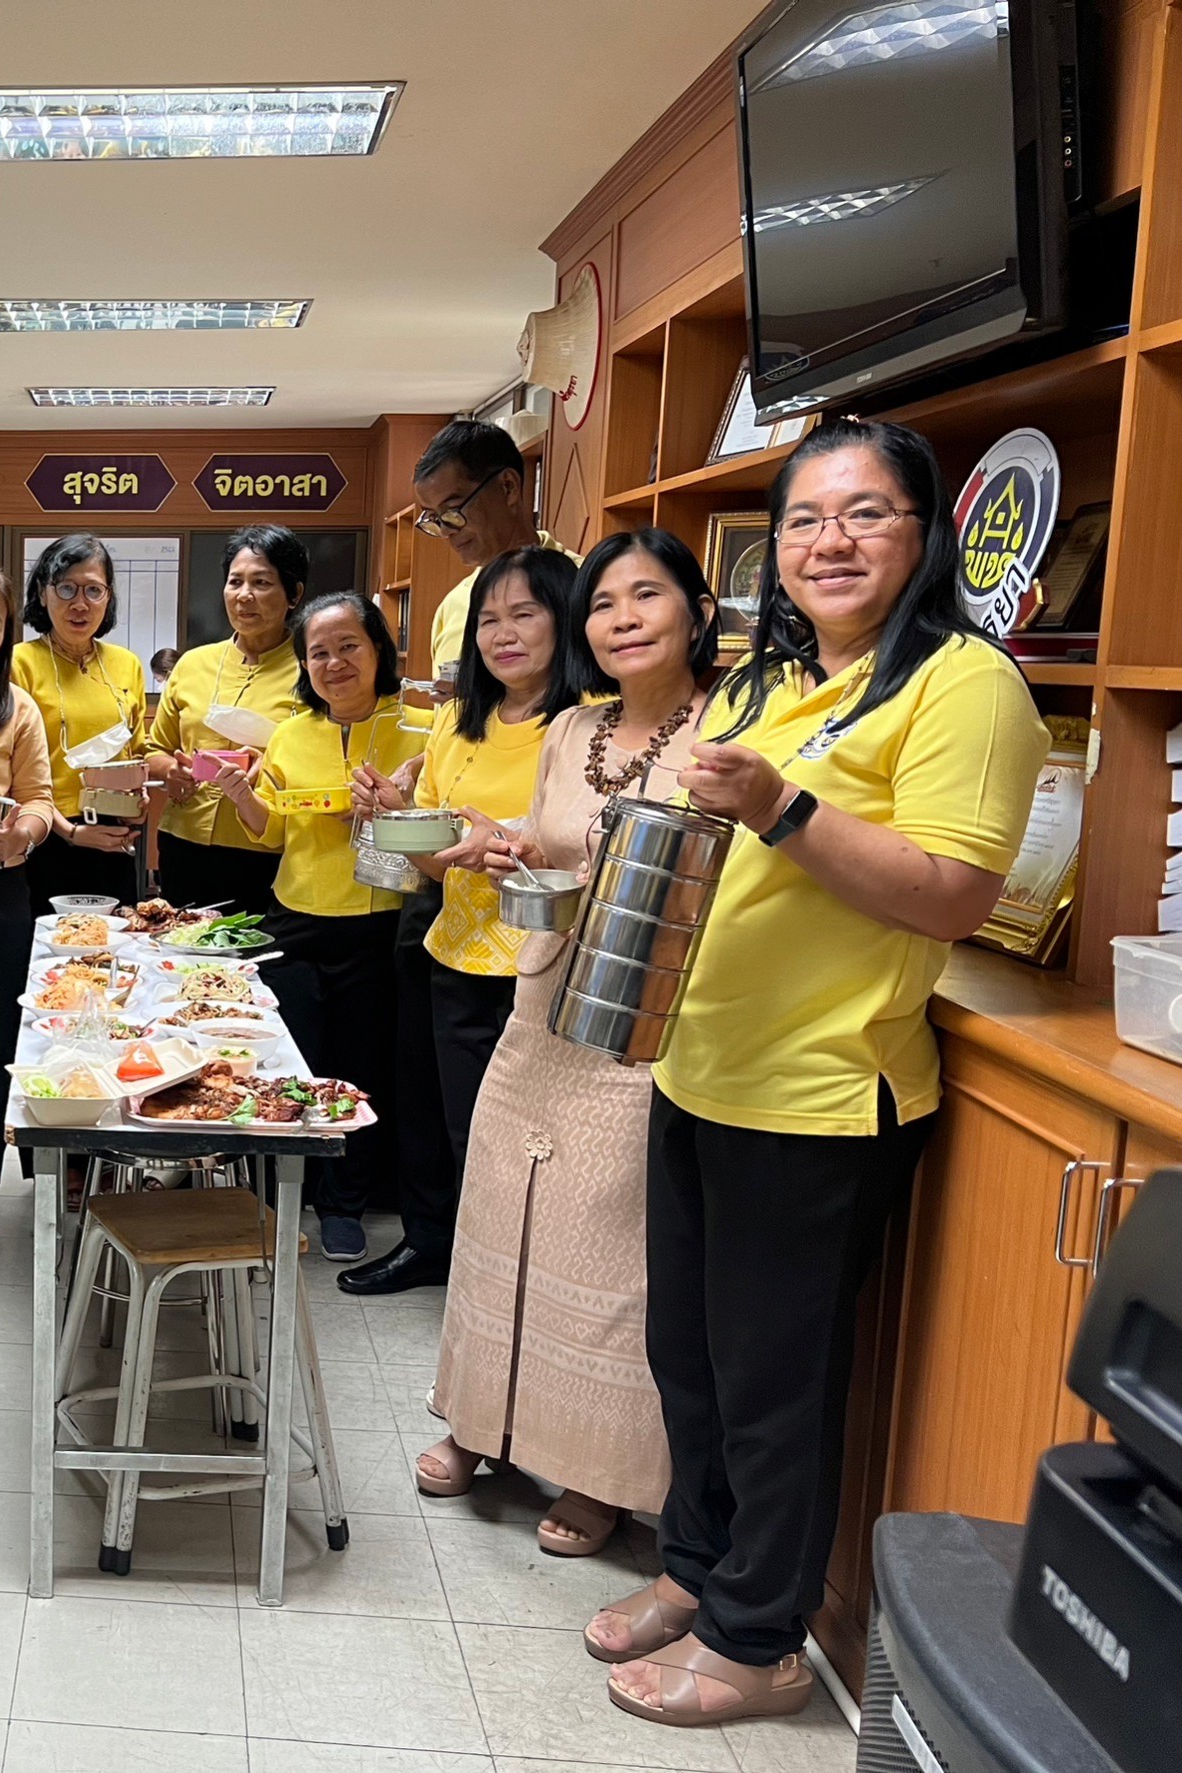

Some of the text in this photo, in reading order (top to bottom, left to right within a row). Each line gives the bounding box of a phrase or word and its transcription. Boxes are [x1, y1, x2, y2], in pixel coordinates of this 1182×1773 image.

[63, 467, 138, 505] สุจริต
[214, 469, 327, 496] จิตอาสา
[1042, 1563, 1130, 1682] TOSHIBA
